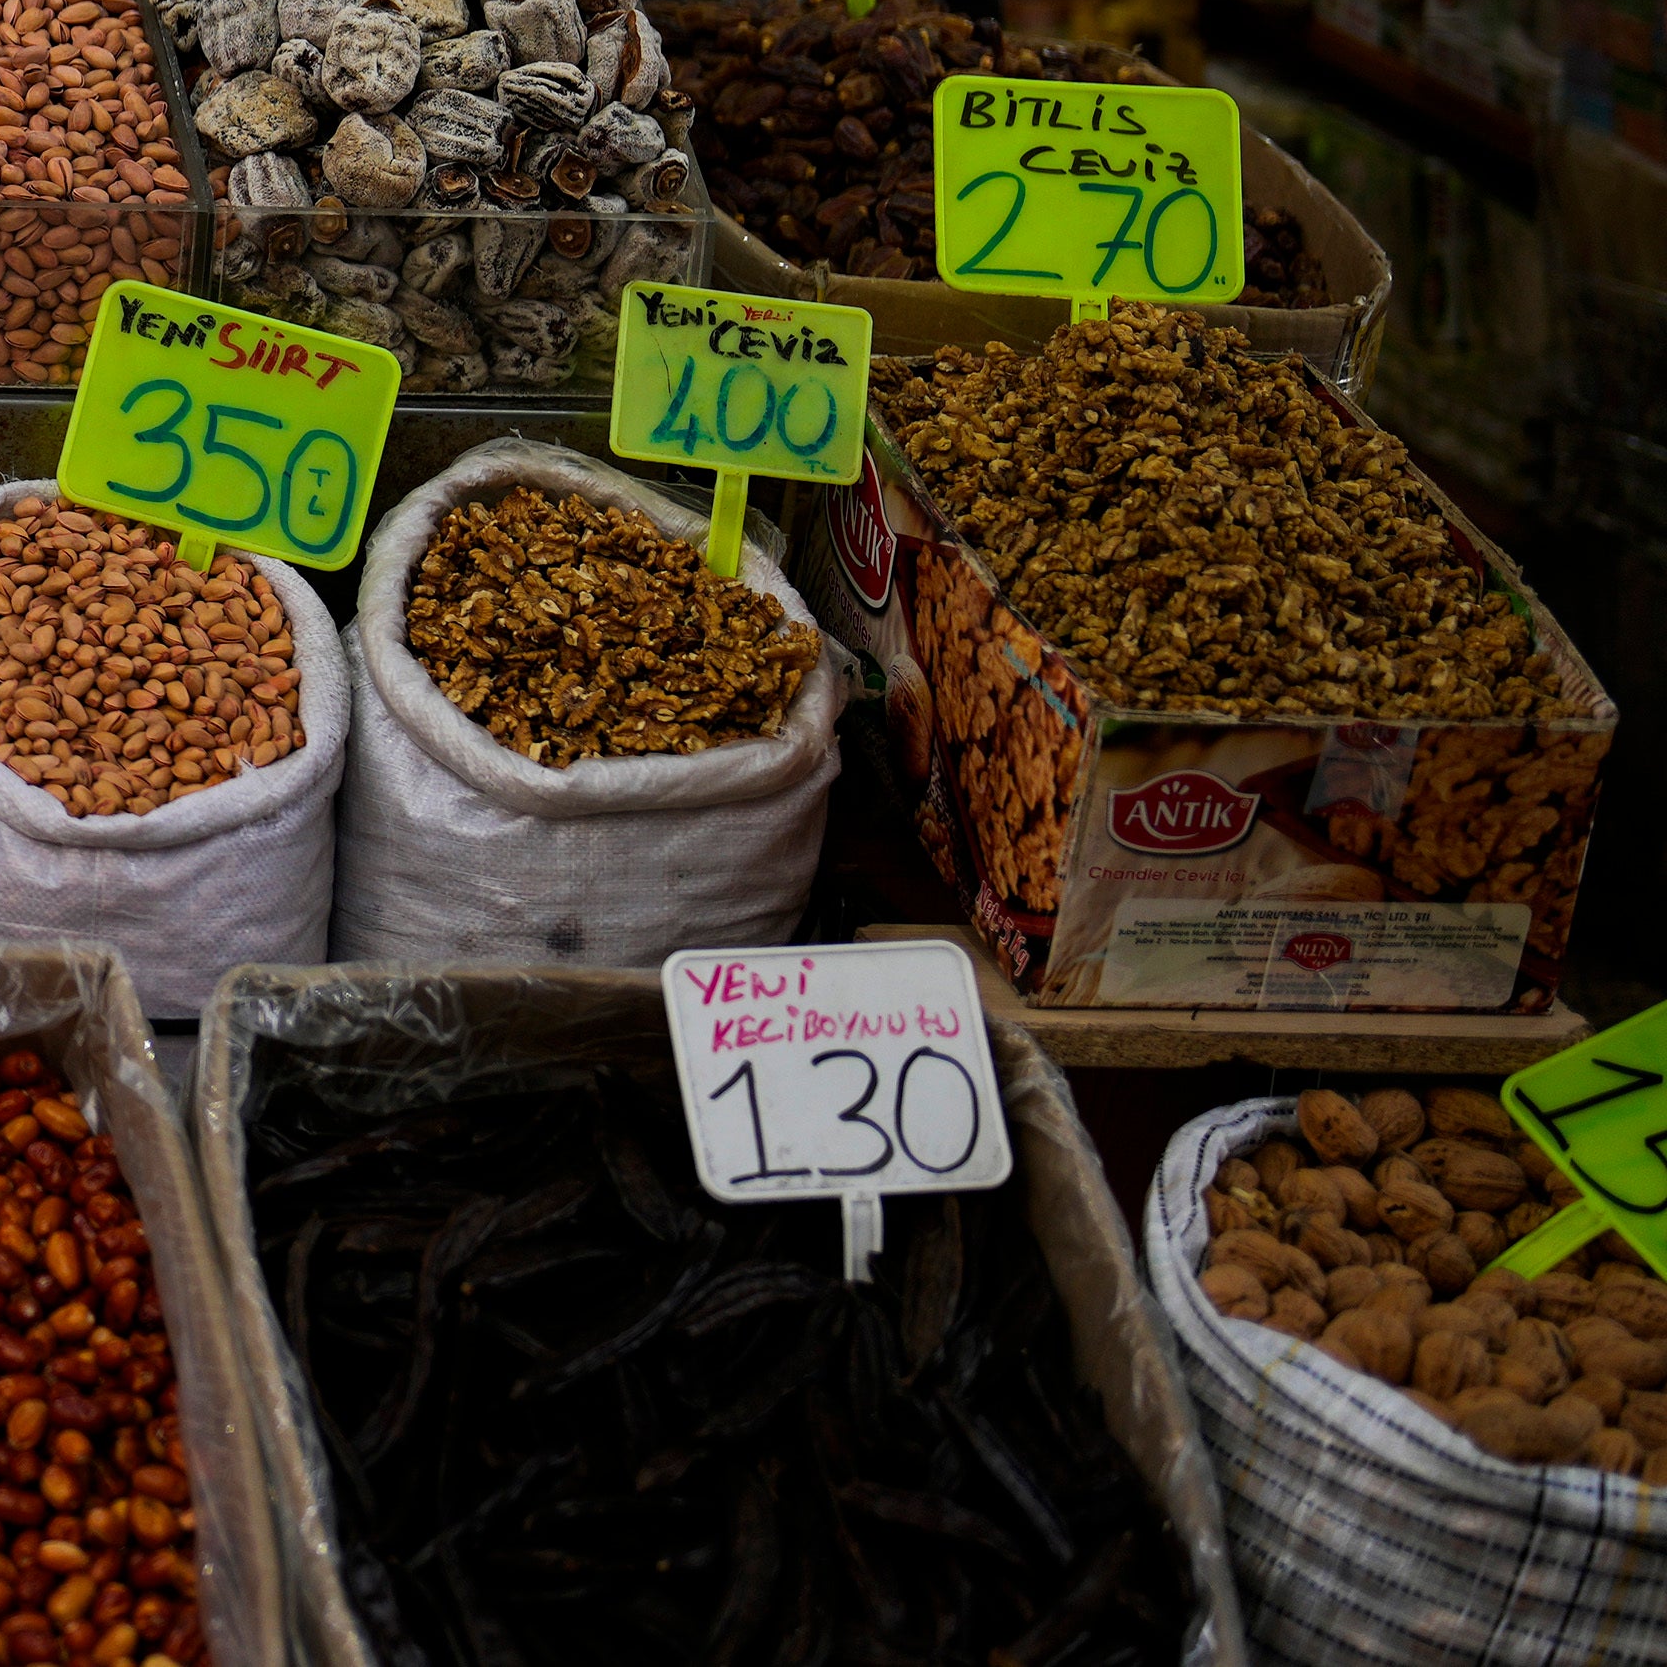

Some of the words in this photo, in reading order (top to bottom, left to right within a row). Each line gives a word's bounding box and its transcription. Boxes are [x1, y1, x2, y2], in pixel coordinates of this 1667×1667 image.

[959, 90, 1149, 137] BİTLİS
[955, 171, 1219, 295] 270
[635, 290, 718, 327] YENİ
[119, 297, 216, 350] YENİ
[208, 320, 363, 391] SİİRT
[708, 317, 850, 367] CEVİZ
[649, 355, 838, 457] 400
[106, 377, 357, 555] 350
[1123, 795, 1235, 834] ANTİK
[1088, 866, 1169, 881] Chandler
[1173, 869, 1220, 883] Ceviz
[684, 957, 816, 1007] YENİ
[709, 1047, 980, 1184] 130
